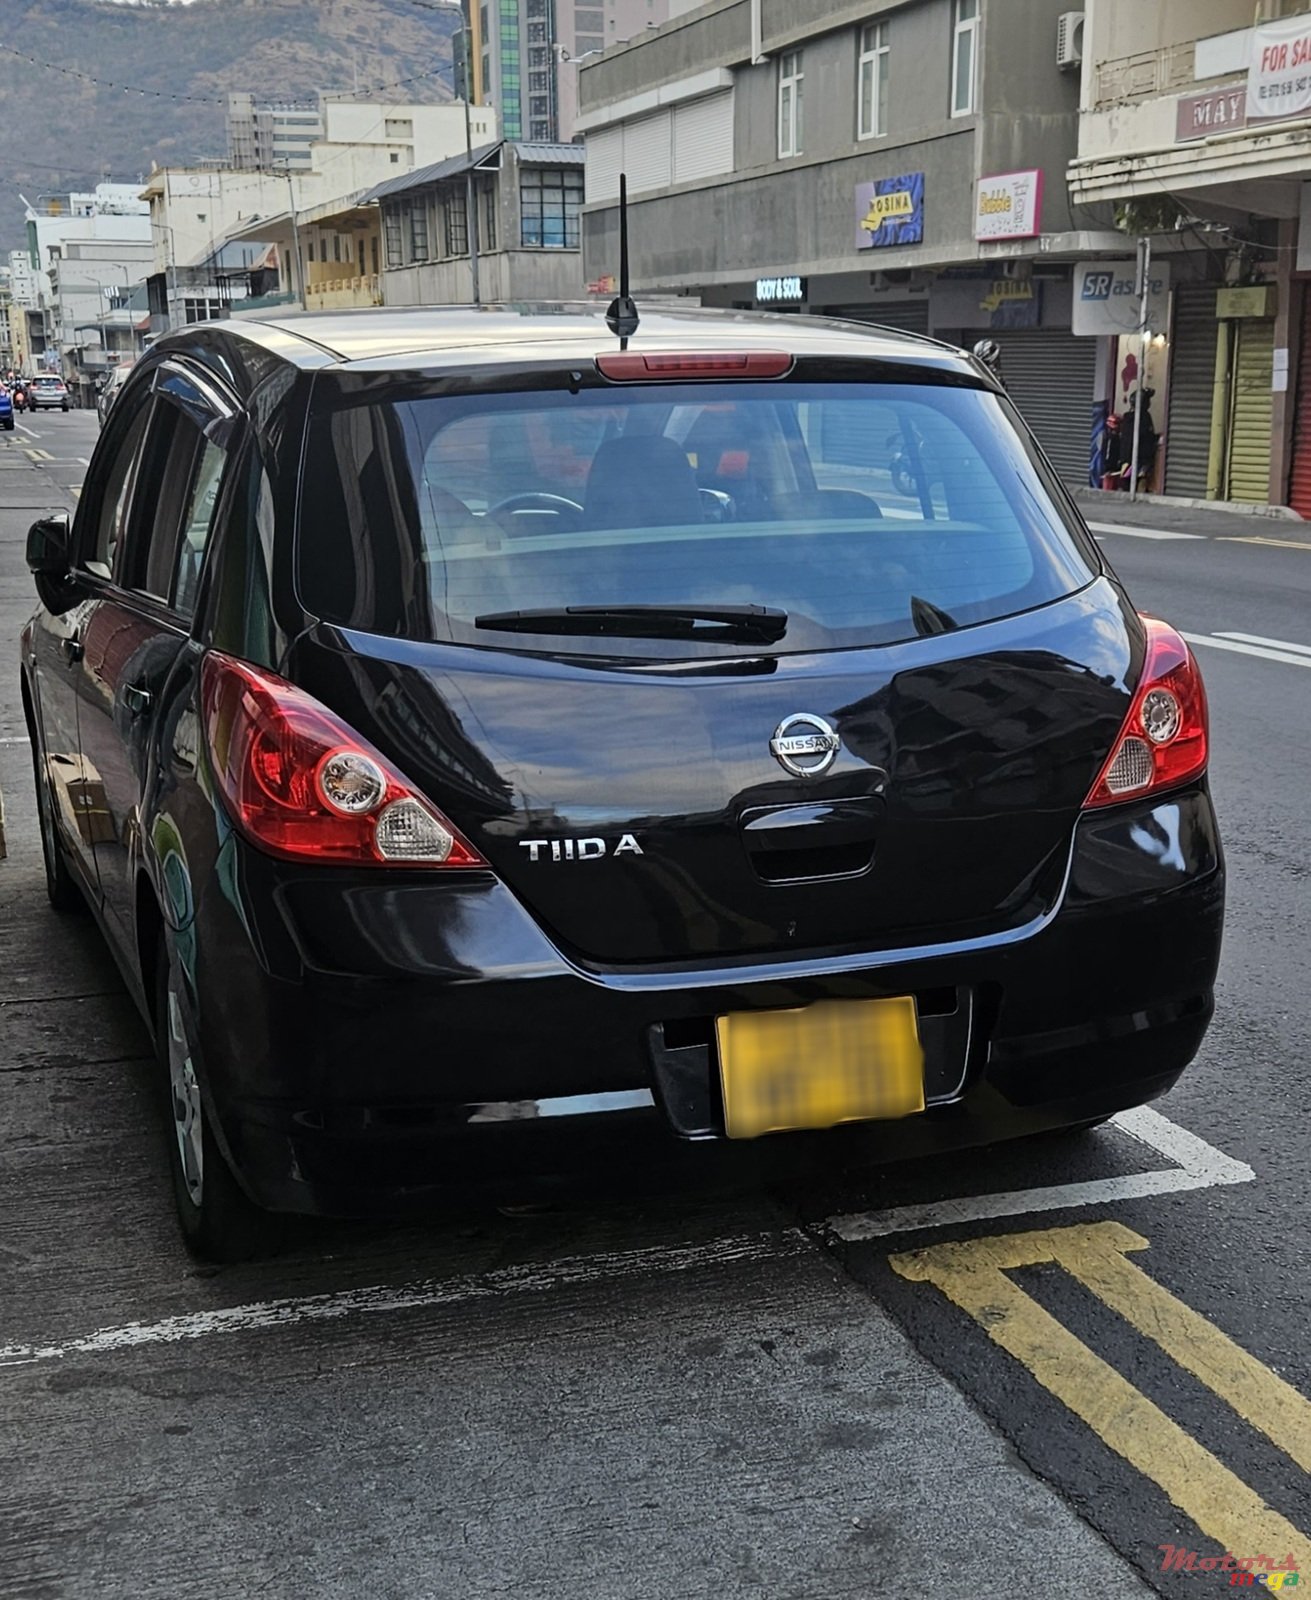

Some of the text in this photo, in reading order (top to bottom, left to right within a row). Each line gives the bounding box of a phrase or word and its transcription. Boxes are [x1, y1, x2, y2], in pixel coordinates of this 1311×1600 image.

[1261, 44, 1288, 72] FOR
[1193, 92, 1243, 127] MAY
[869, 195, 909, 213] ROSINA
[979, 188, 1011, 216] Bubble
[782, 276, 803, 300] SOUL
[1084, 275, 1163, 296] SR asre
[779, 736, 833, 751] NISSAN
[518, 833, 644, 862] TIIDA
